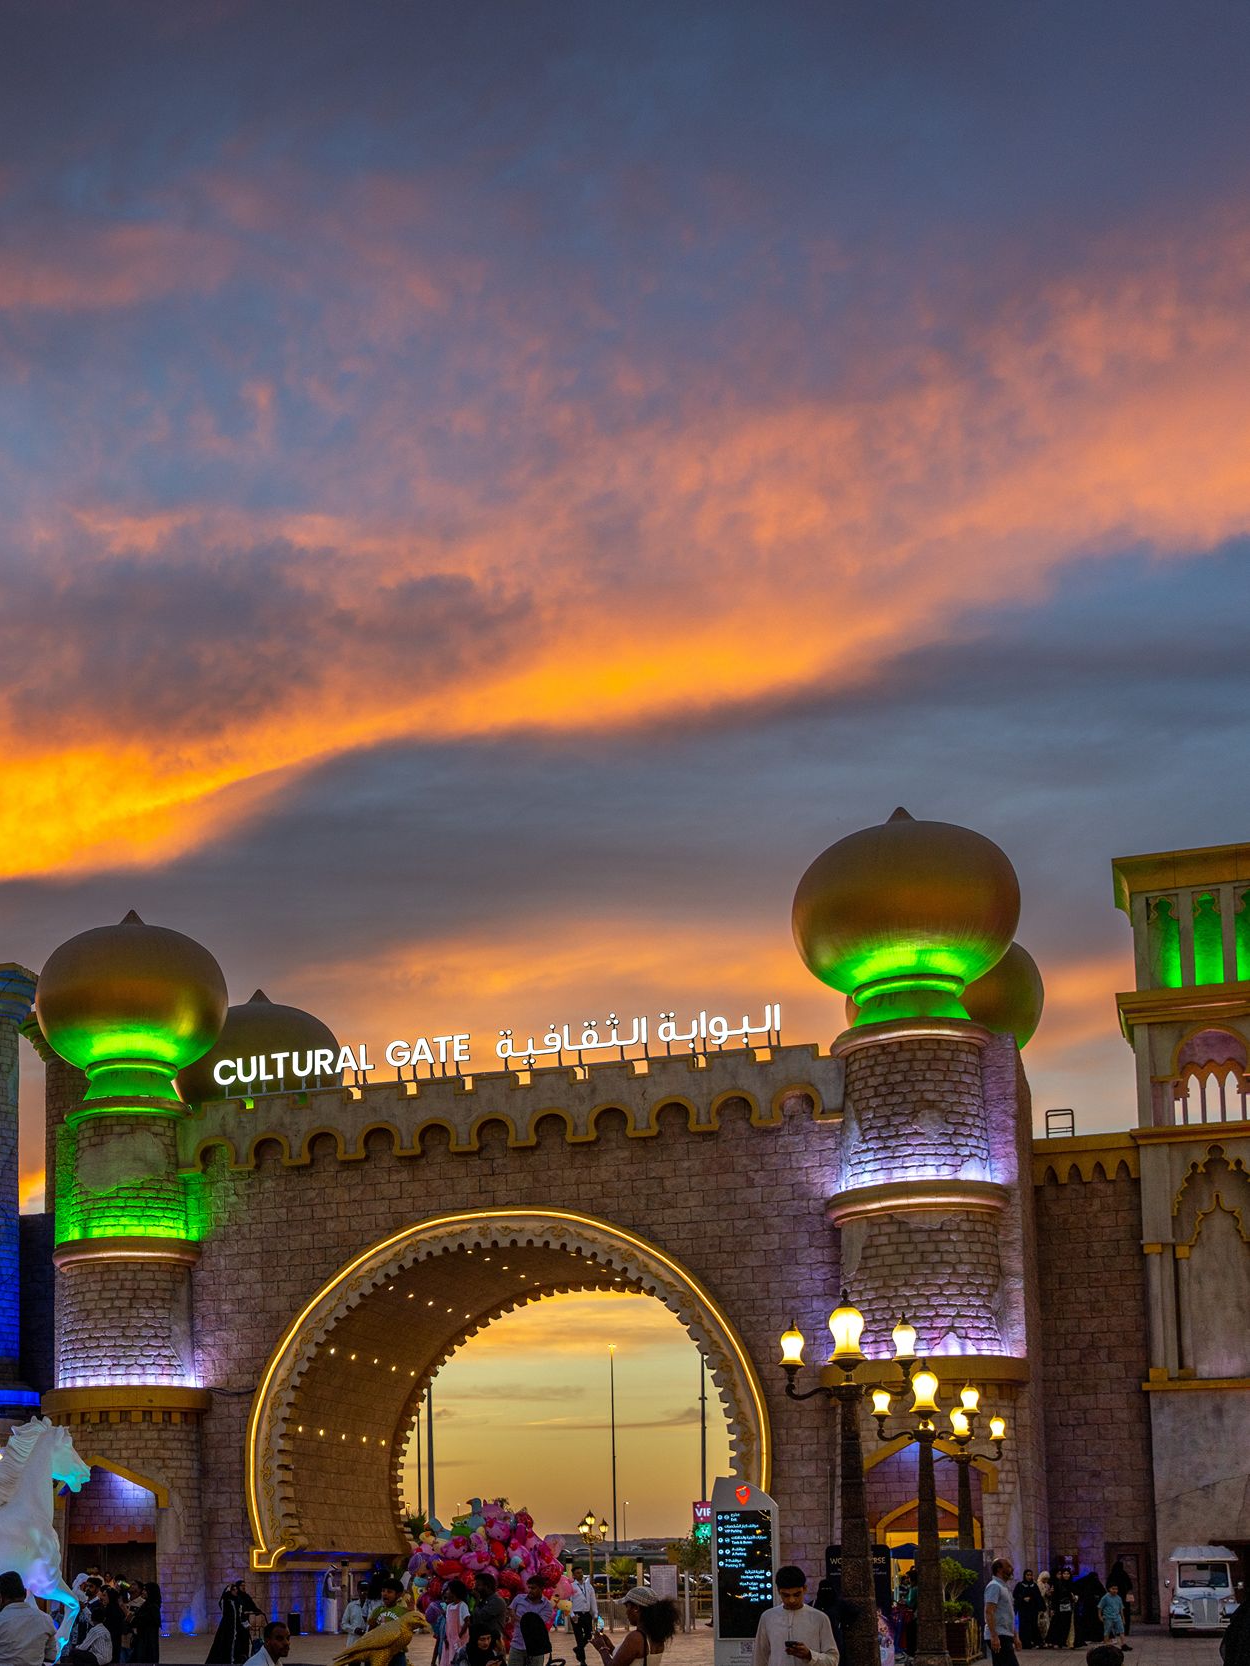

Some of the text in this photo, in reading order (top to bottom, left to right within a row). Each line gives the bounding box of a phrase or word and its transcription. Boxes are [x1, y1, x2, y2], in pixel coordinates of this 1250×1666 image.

[213, 1033, 471, 1086] CULTURAL GATE
[495, 1003, 781, 1065] البوابة الثقافية
